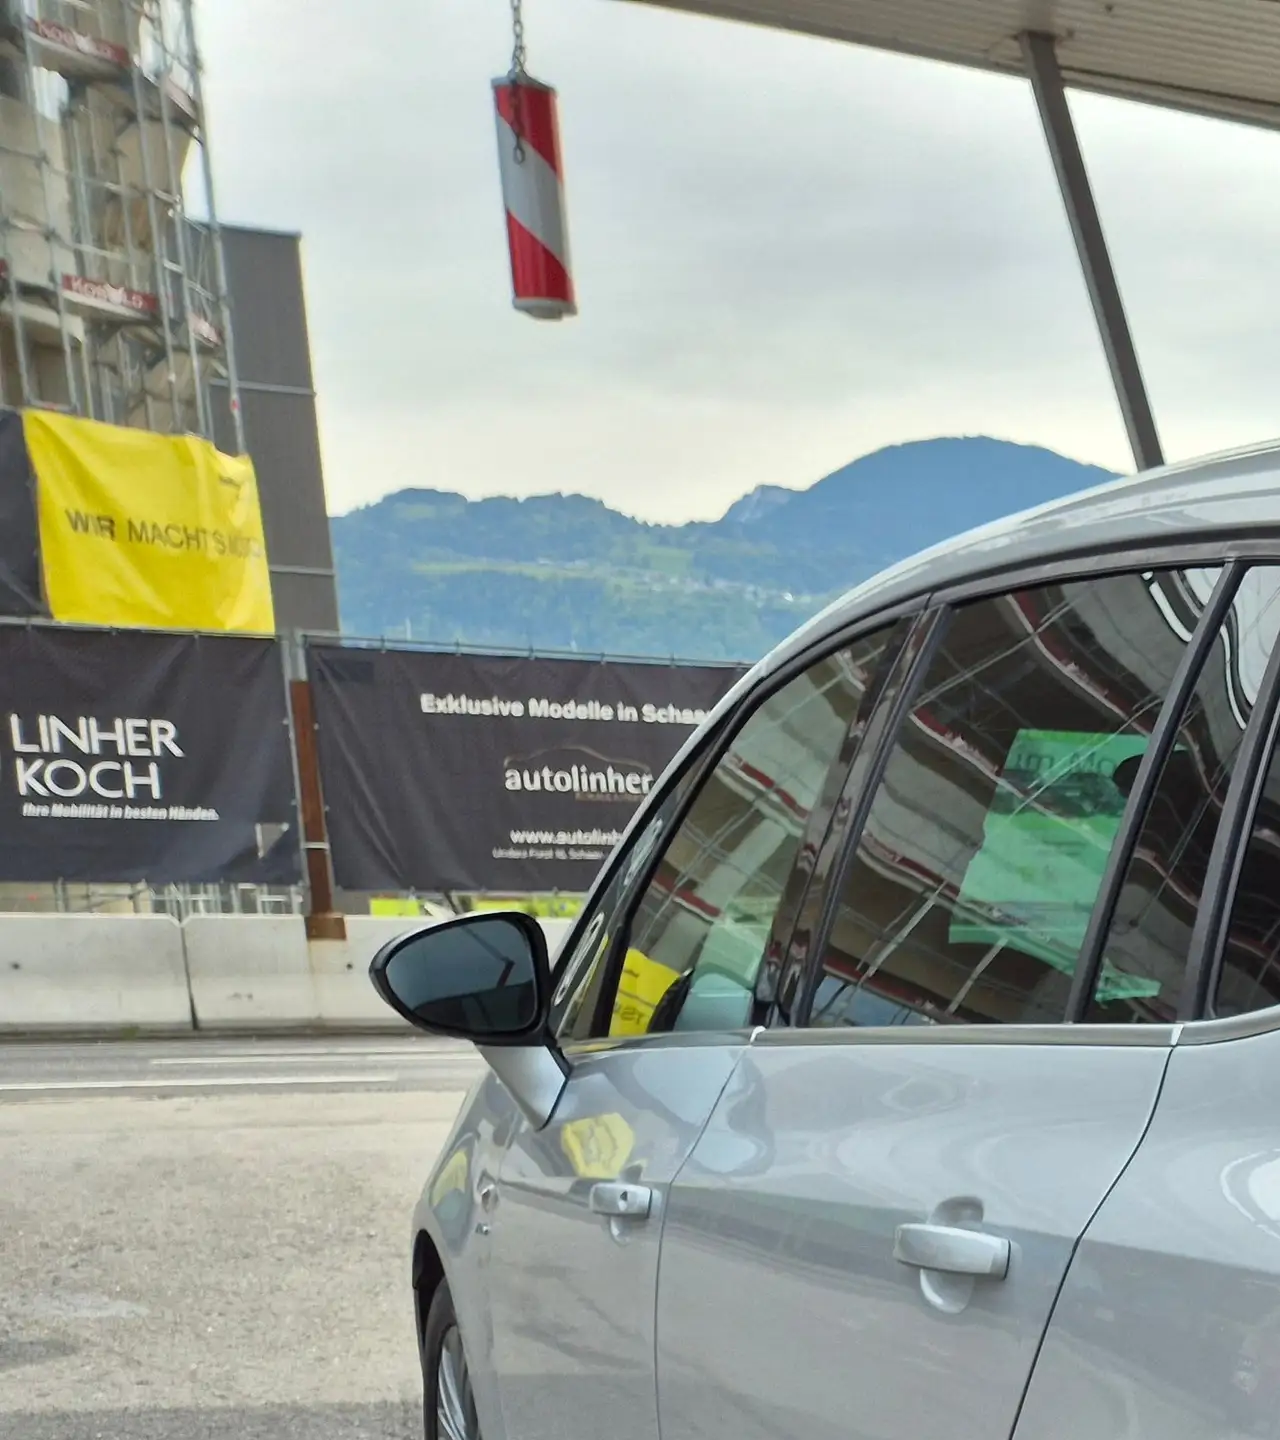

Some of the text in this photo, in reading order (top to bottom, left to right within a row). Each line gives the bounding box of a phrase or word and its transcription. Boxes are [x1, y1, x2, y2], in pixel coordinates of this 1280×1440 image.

[65, 509, 116, 541] WIR
[420, 693, 711, 724] Exklusive Modelle in Schaa
[10, 713, 186, 757] LINHER
[16, 757, 161, 799] KOCH
[505, 764, 655, 794] autolinher
[23, 802, 50, 816] Ihre
[51, 803, 109, 818] Mobilität
[110, 804, 123, 818] in
[124, 805, 167, 820] besten
